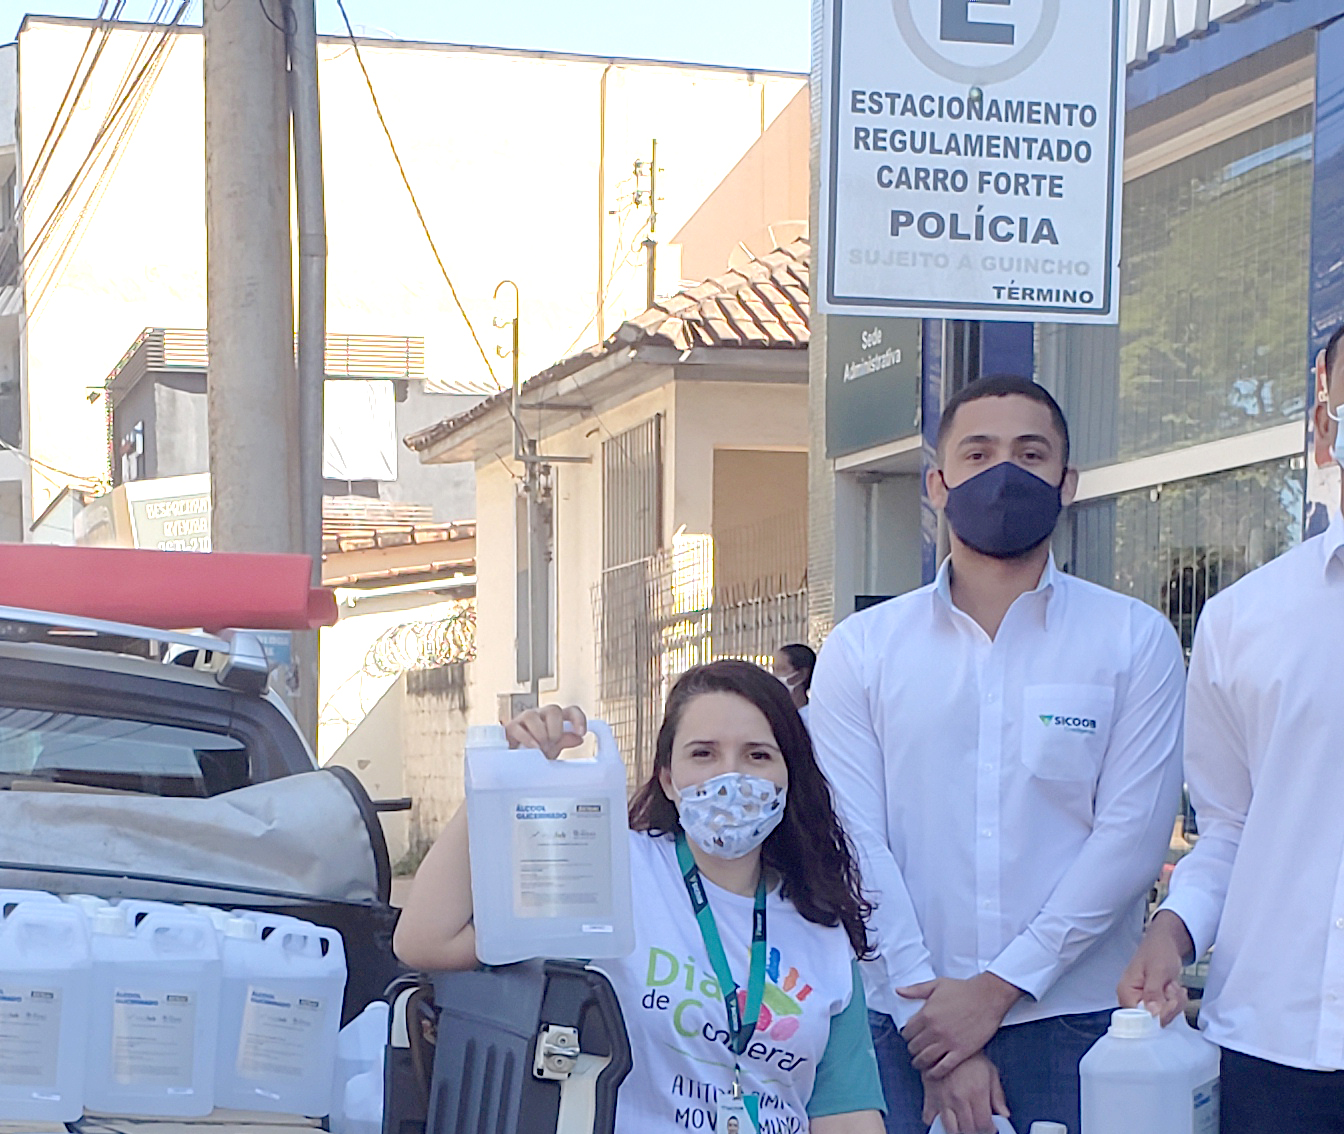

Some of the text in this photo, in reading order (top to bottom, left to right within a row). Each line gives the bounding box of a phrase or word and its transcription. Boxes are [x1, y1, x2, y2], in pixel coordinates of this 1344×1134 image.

[850, 90, 1097, 127] ESTACIONAMENTO
[853, 127, 1092, 163] REGULAMENTADO
[876, 165, 1064, 198] CARRO FORTE
[889, 205, 1059, 245] POLÍCIA
[849, 249, 1091, 276] SUJEITO A GUINCHO
[992, 280, 1094, 304] TÉRMINO
[861, 326, 882, 350] Sede
[843, 347, 901, 383] Administrativa
[1054, 716, 1096, 728] SICOOB
[646, 947, 722, 1003] Dia
[642, 989, 670, 1010] de
[675, 1107, 718, 1132] MOV
